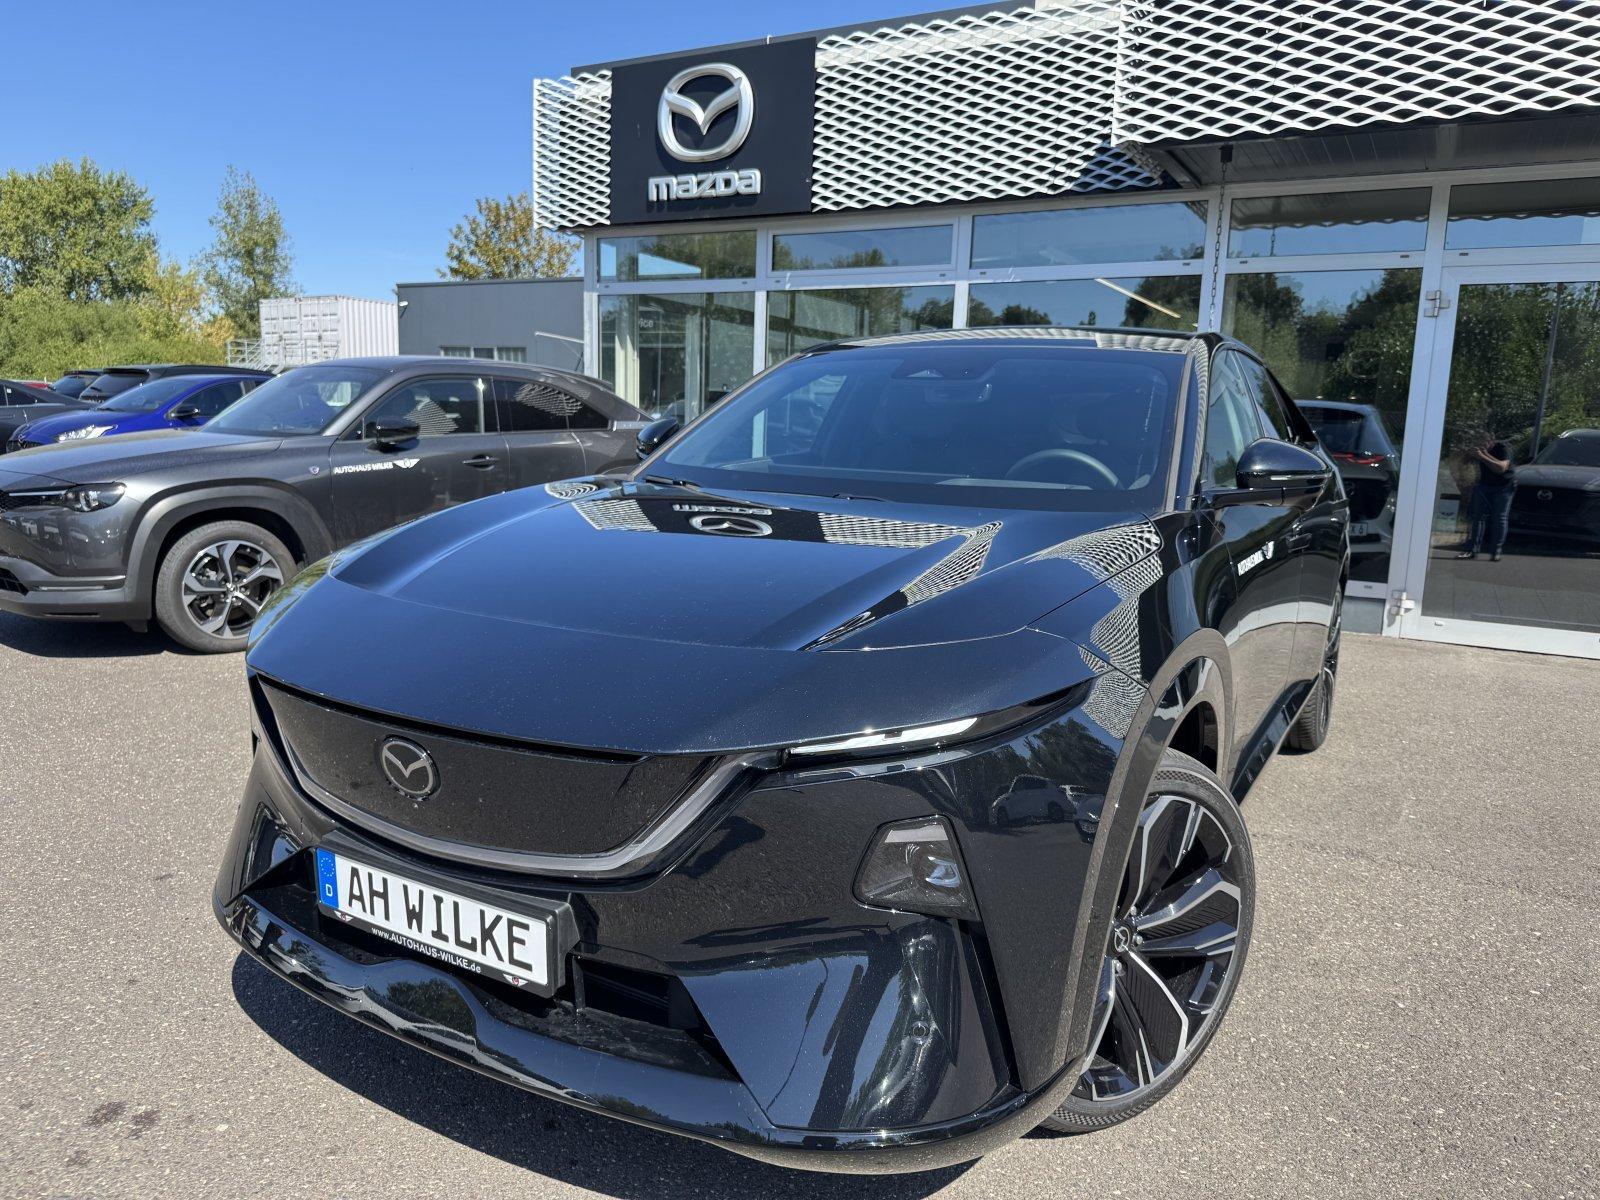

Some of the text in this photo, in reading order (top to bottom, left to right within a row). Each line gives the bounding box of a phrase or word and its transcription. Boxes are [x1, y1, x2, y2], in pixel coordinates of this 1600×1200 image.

[648, 168, 762, 202] mazda
[333, 463, 372, 474] AUTOHAUS
[325, 866, 533, 972] D AH WILKE
[371, 927, 482, 974] www.AUTOHAUS-WILKE.de
